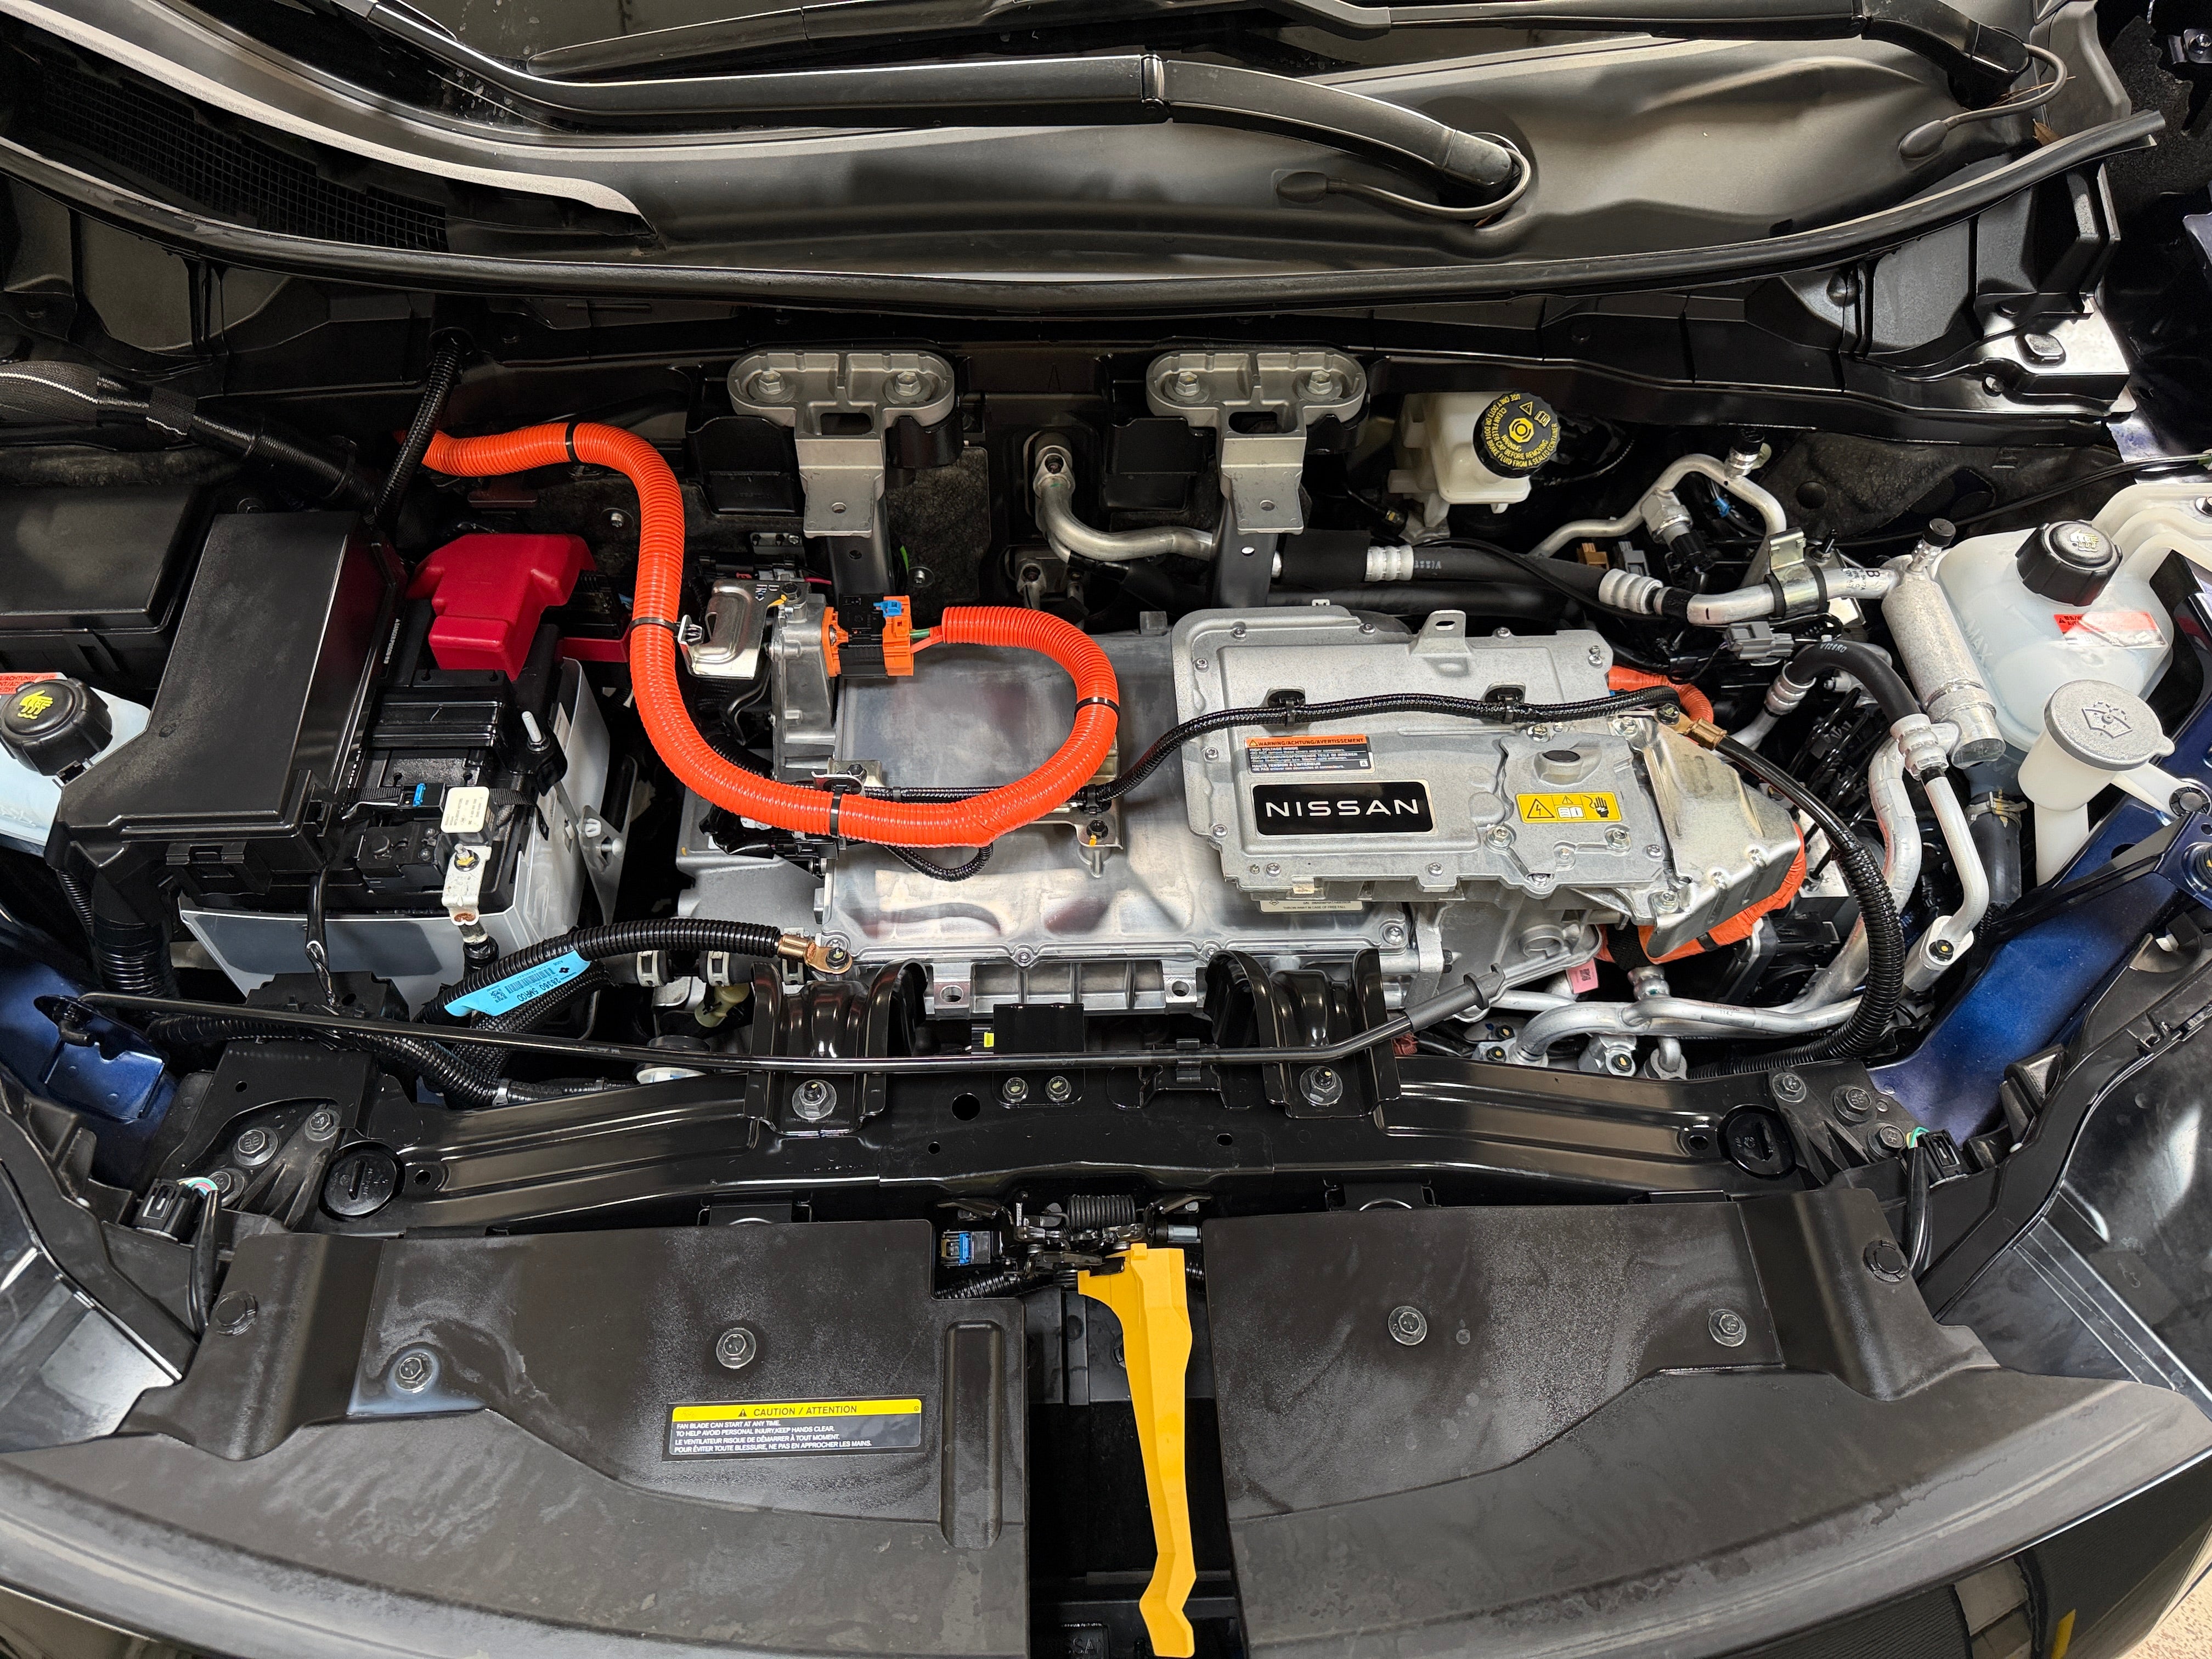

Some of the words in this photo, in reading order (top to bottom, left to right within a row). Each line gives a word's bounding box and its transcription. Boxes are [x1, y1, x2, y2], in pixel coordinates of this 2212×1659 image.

[1498, 396, 1510, 407] ONLY
[1510, 393, 1521, 402] USE
[1493, 407, 1507, 424] CLEAN
[1491, 423, 1500, 442] FILLER
[1547, 423, 1559, 452] CONTAINER
[1486, 439, 1500, 456] BRAKE
[1496, 440, 1506, 451] CAP
[1501, 434, 1522, 452] WARNING
[1525, 439, 1549, 459] REMOVING
[1498, 453, 1513, 465] FLUID
[1504, 449, 1525, 460] BEFORE
[1533, 450, 1550, 465] SEALED
[1258, 738, 1363, 746] WARNING/ACHTUNG/AVERTISSEMENT
[1265, 798, 1419, 818] NISSAN
[753, 1407, 795, 1417] CAUTION
[806, 1405, 857, 1414] ATTENTION
[756, 1434, 789, 1443] DÉMARRER
[790, 1434, 796, 1442] À
[692, 1444, 714, 1453] ÉVITER
